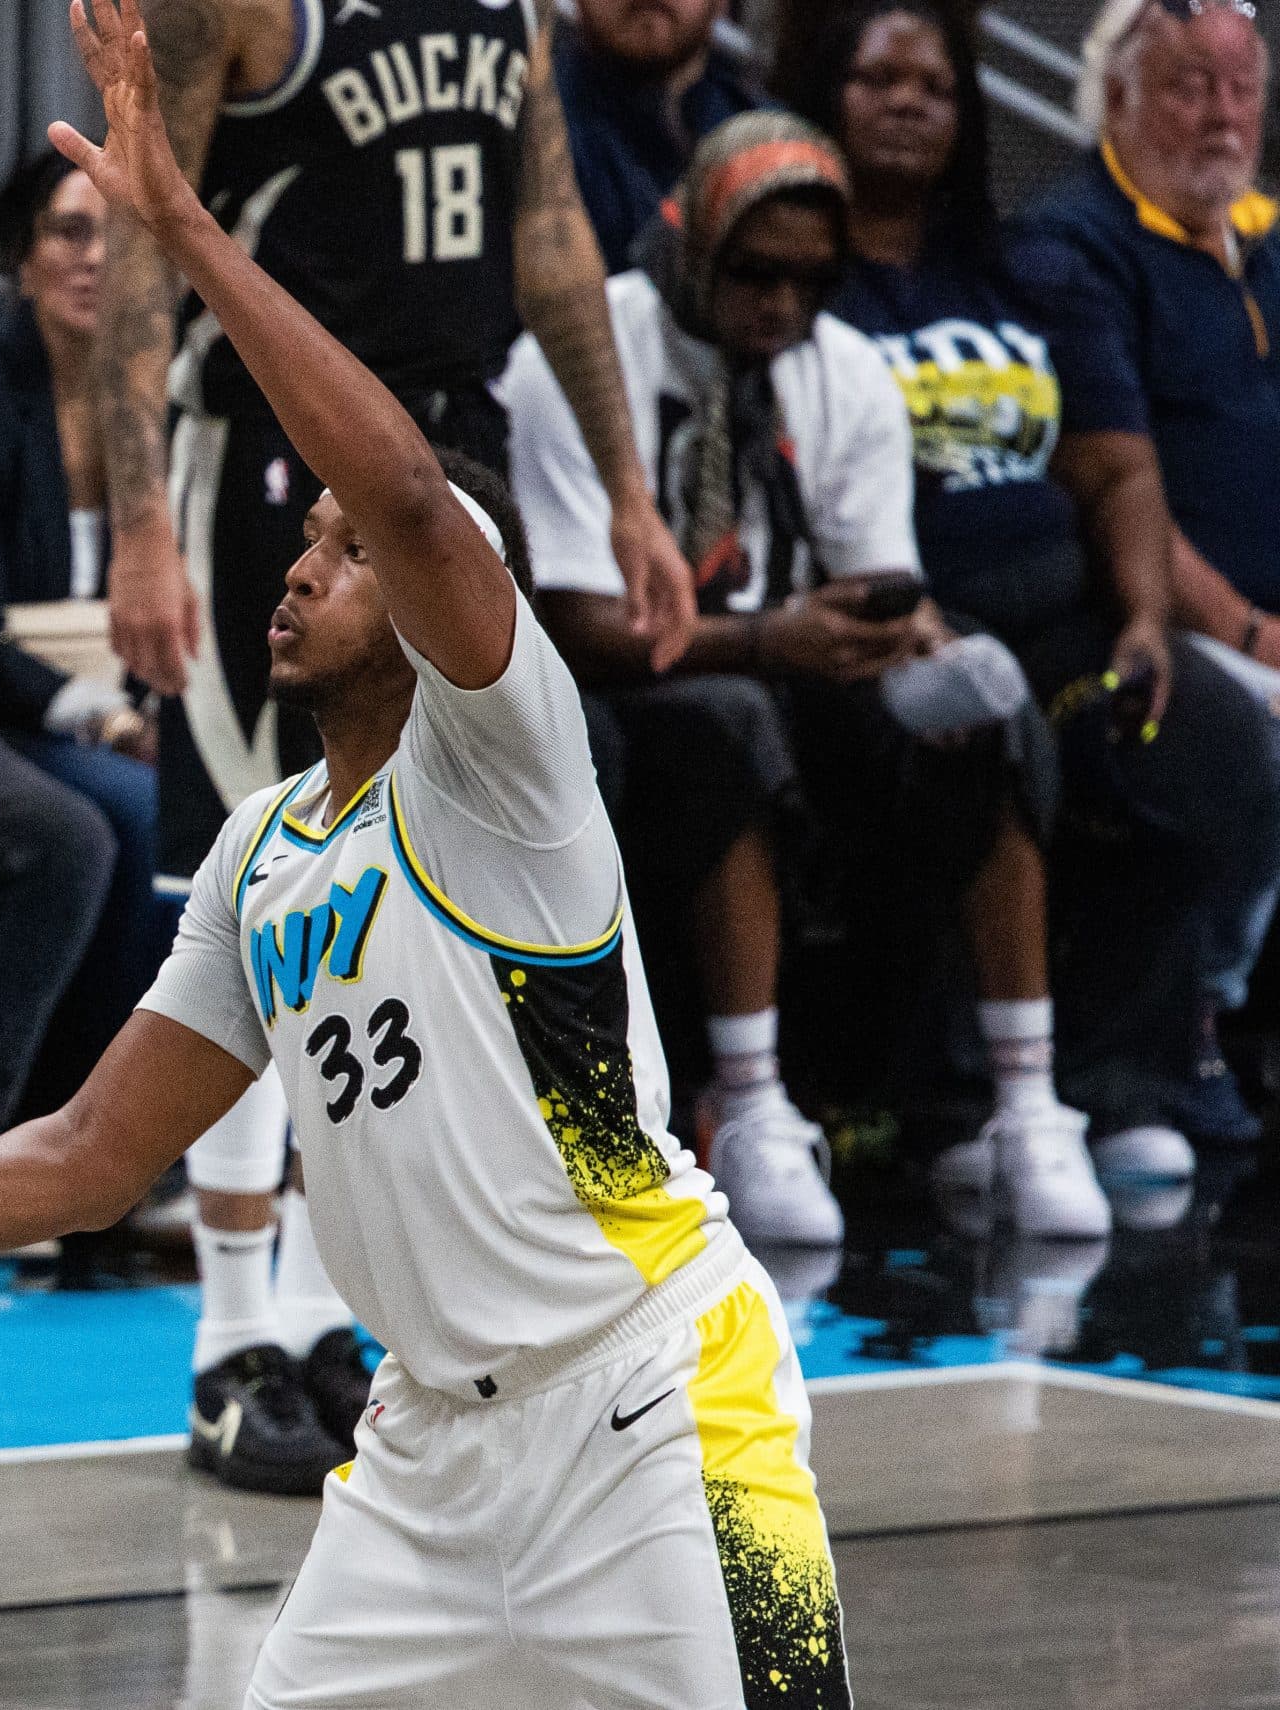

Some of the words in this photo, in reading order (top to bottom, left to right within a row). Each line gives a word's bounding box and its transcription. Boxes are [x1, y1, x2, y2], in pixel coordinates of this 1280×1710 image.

[321, 32, 528, 147] BUCKS
[396, 142, 483, 264] 18
[304, 996, 423, 1126] 33
